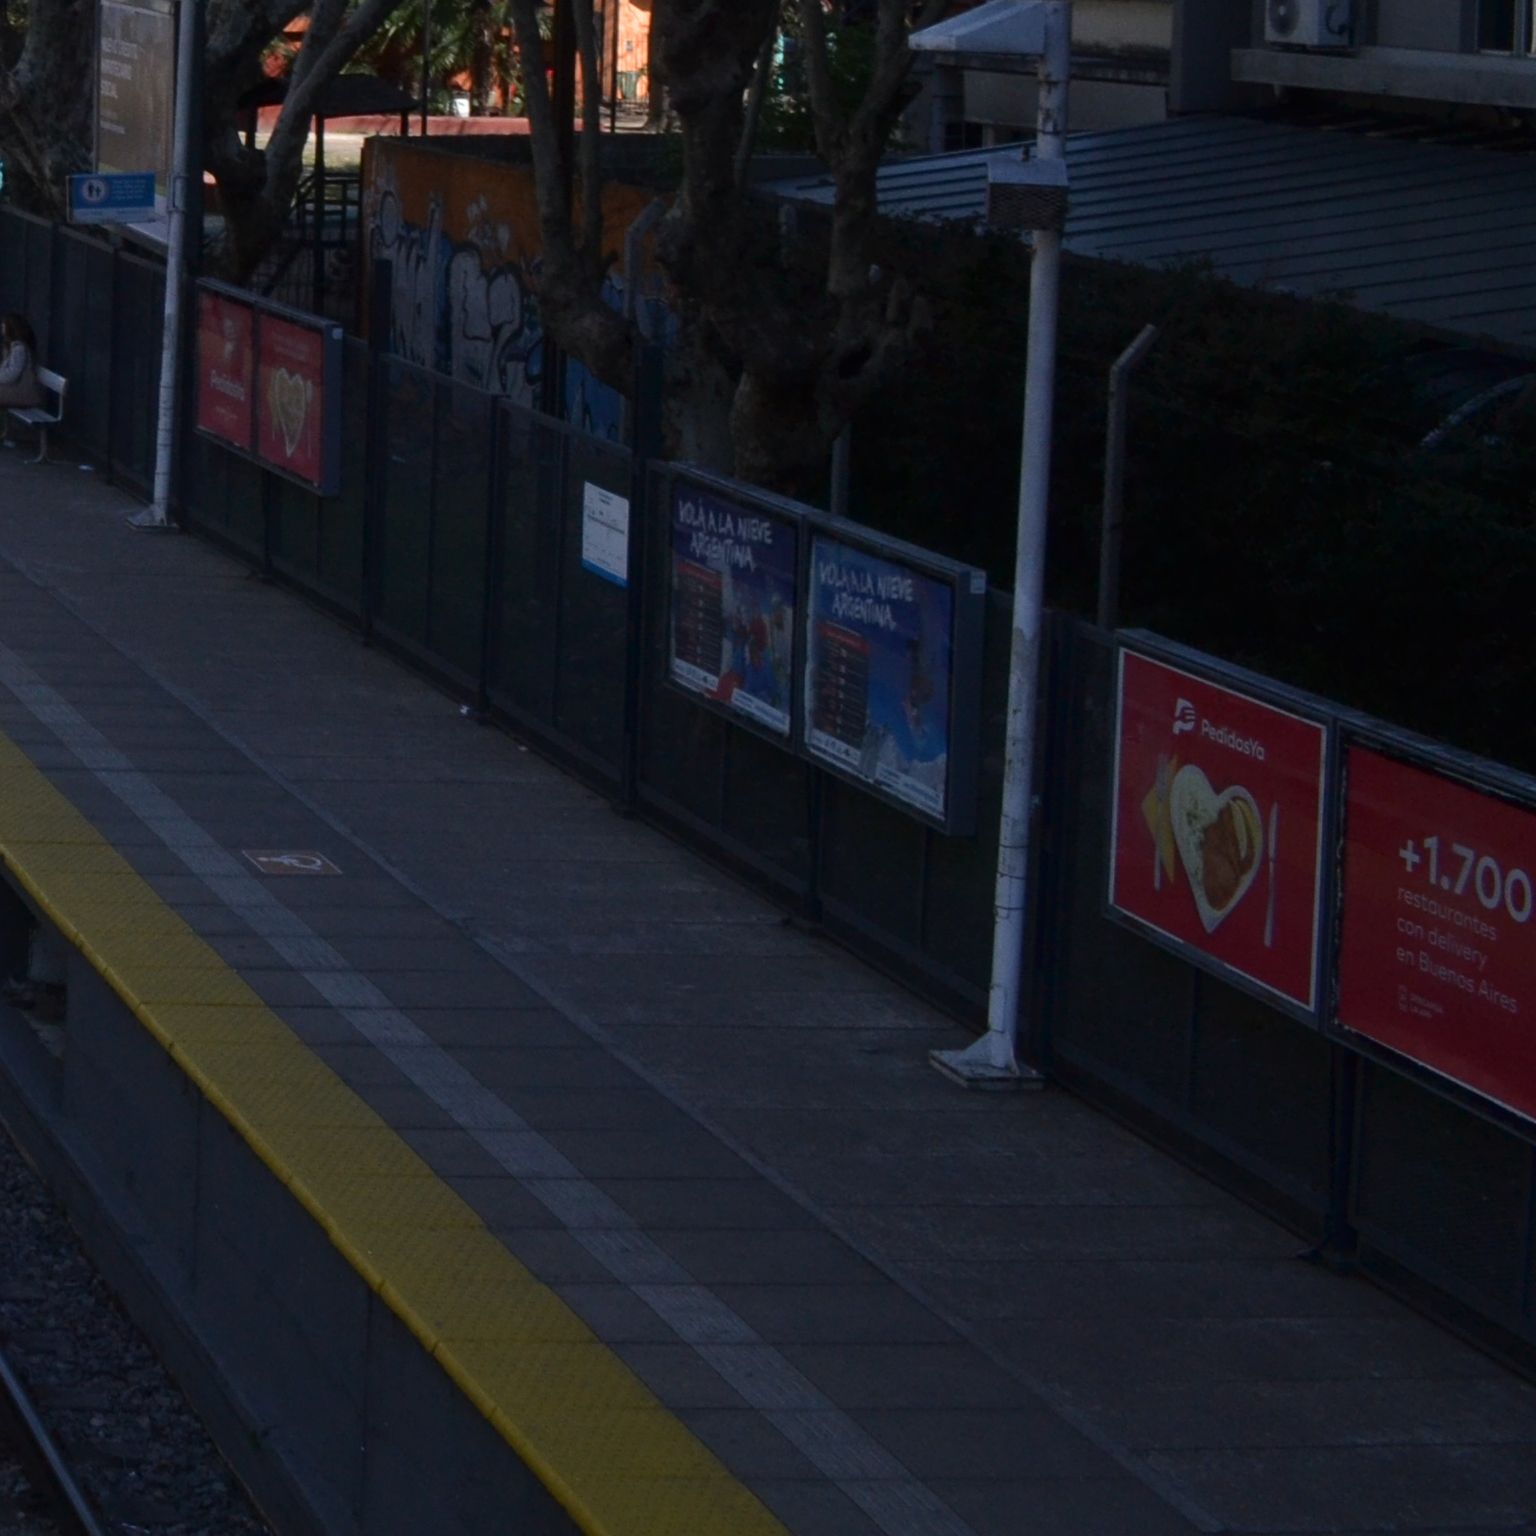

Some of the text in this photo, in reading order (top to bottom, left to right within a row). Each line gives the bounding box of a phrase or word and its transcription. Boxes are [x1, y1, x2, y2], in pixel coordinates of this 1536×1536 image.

[719, 513, 735, 538] LA
[737, 517, 773, 545] NIEVE
[858, 572, 875, 598] LA
[877, 574, 914, 604] NIEVE
[1200, 722, 1266, 761] PedidosYa
[1397, 835, 1533, 924] +1.700
[1396, 887, 1498, 942] restaurantes
[1396, 912, 1489, 973] con delivery
[1395, 940, 1518, 1015] en Buenos Aires
